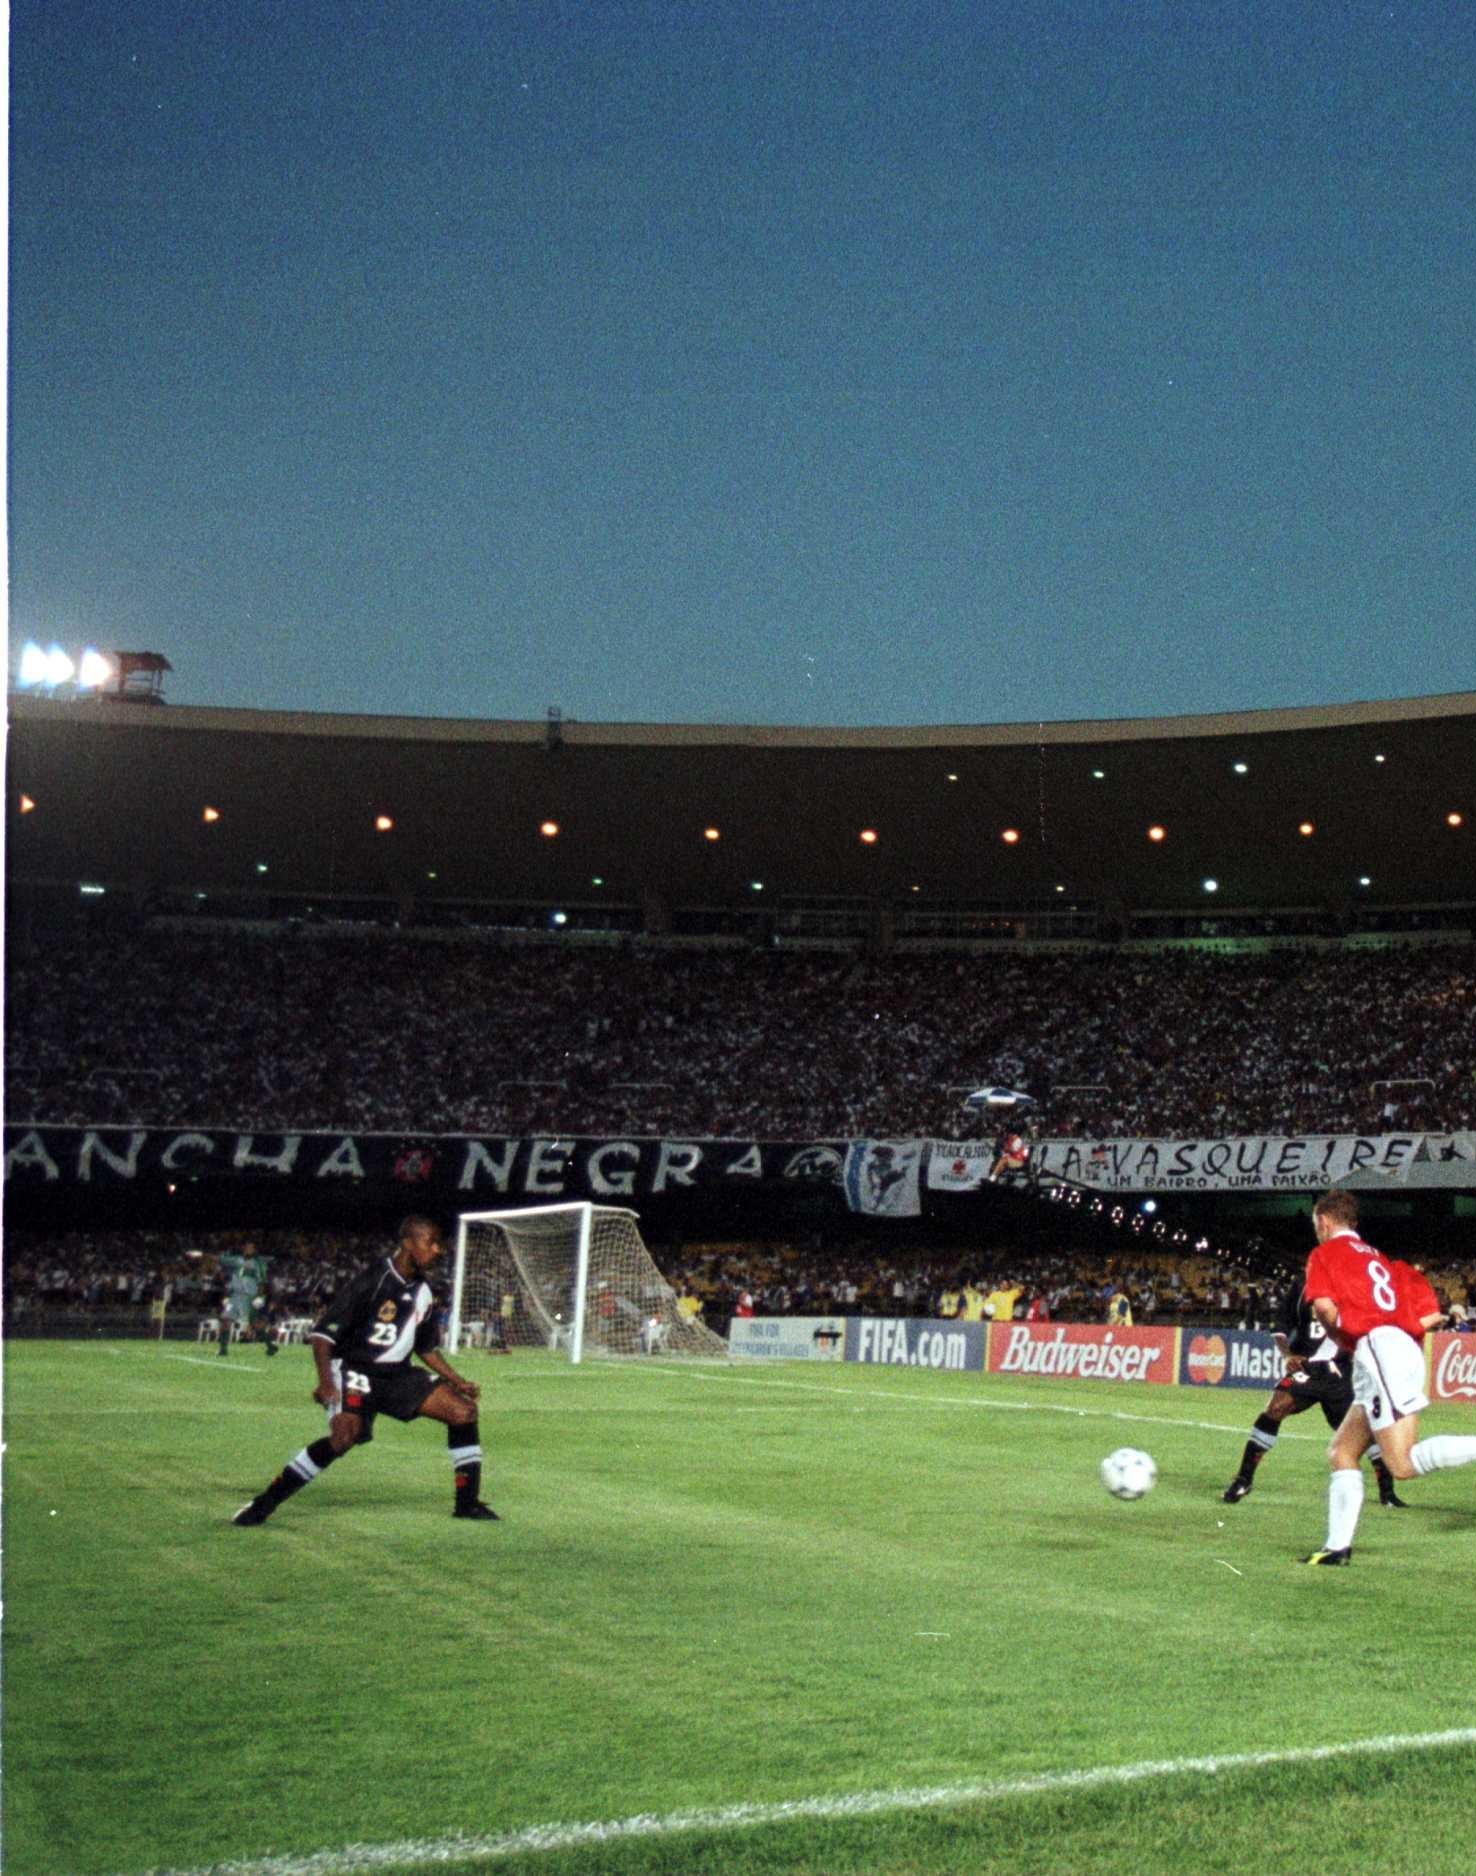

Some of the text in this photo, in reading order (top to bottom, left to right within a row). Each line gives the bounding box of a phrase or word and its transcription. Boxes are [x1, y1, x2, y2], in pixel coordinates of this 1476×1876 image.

[1368, 1259, 1396, 1312] 8
[368, 1322, 398, 1346] 23
[858, 1319, 967, 1369] FIFA.com
[1000, 1326, 1161, 1381] Budweiser
[346, 1370, 371, 1393] 23
